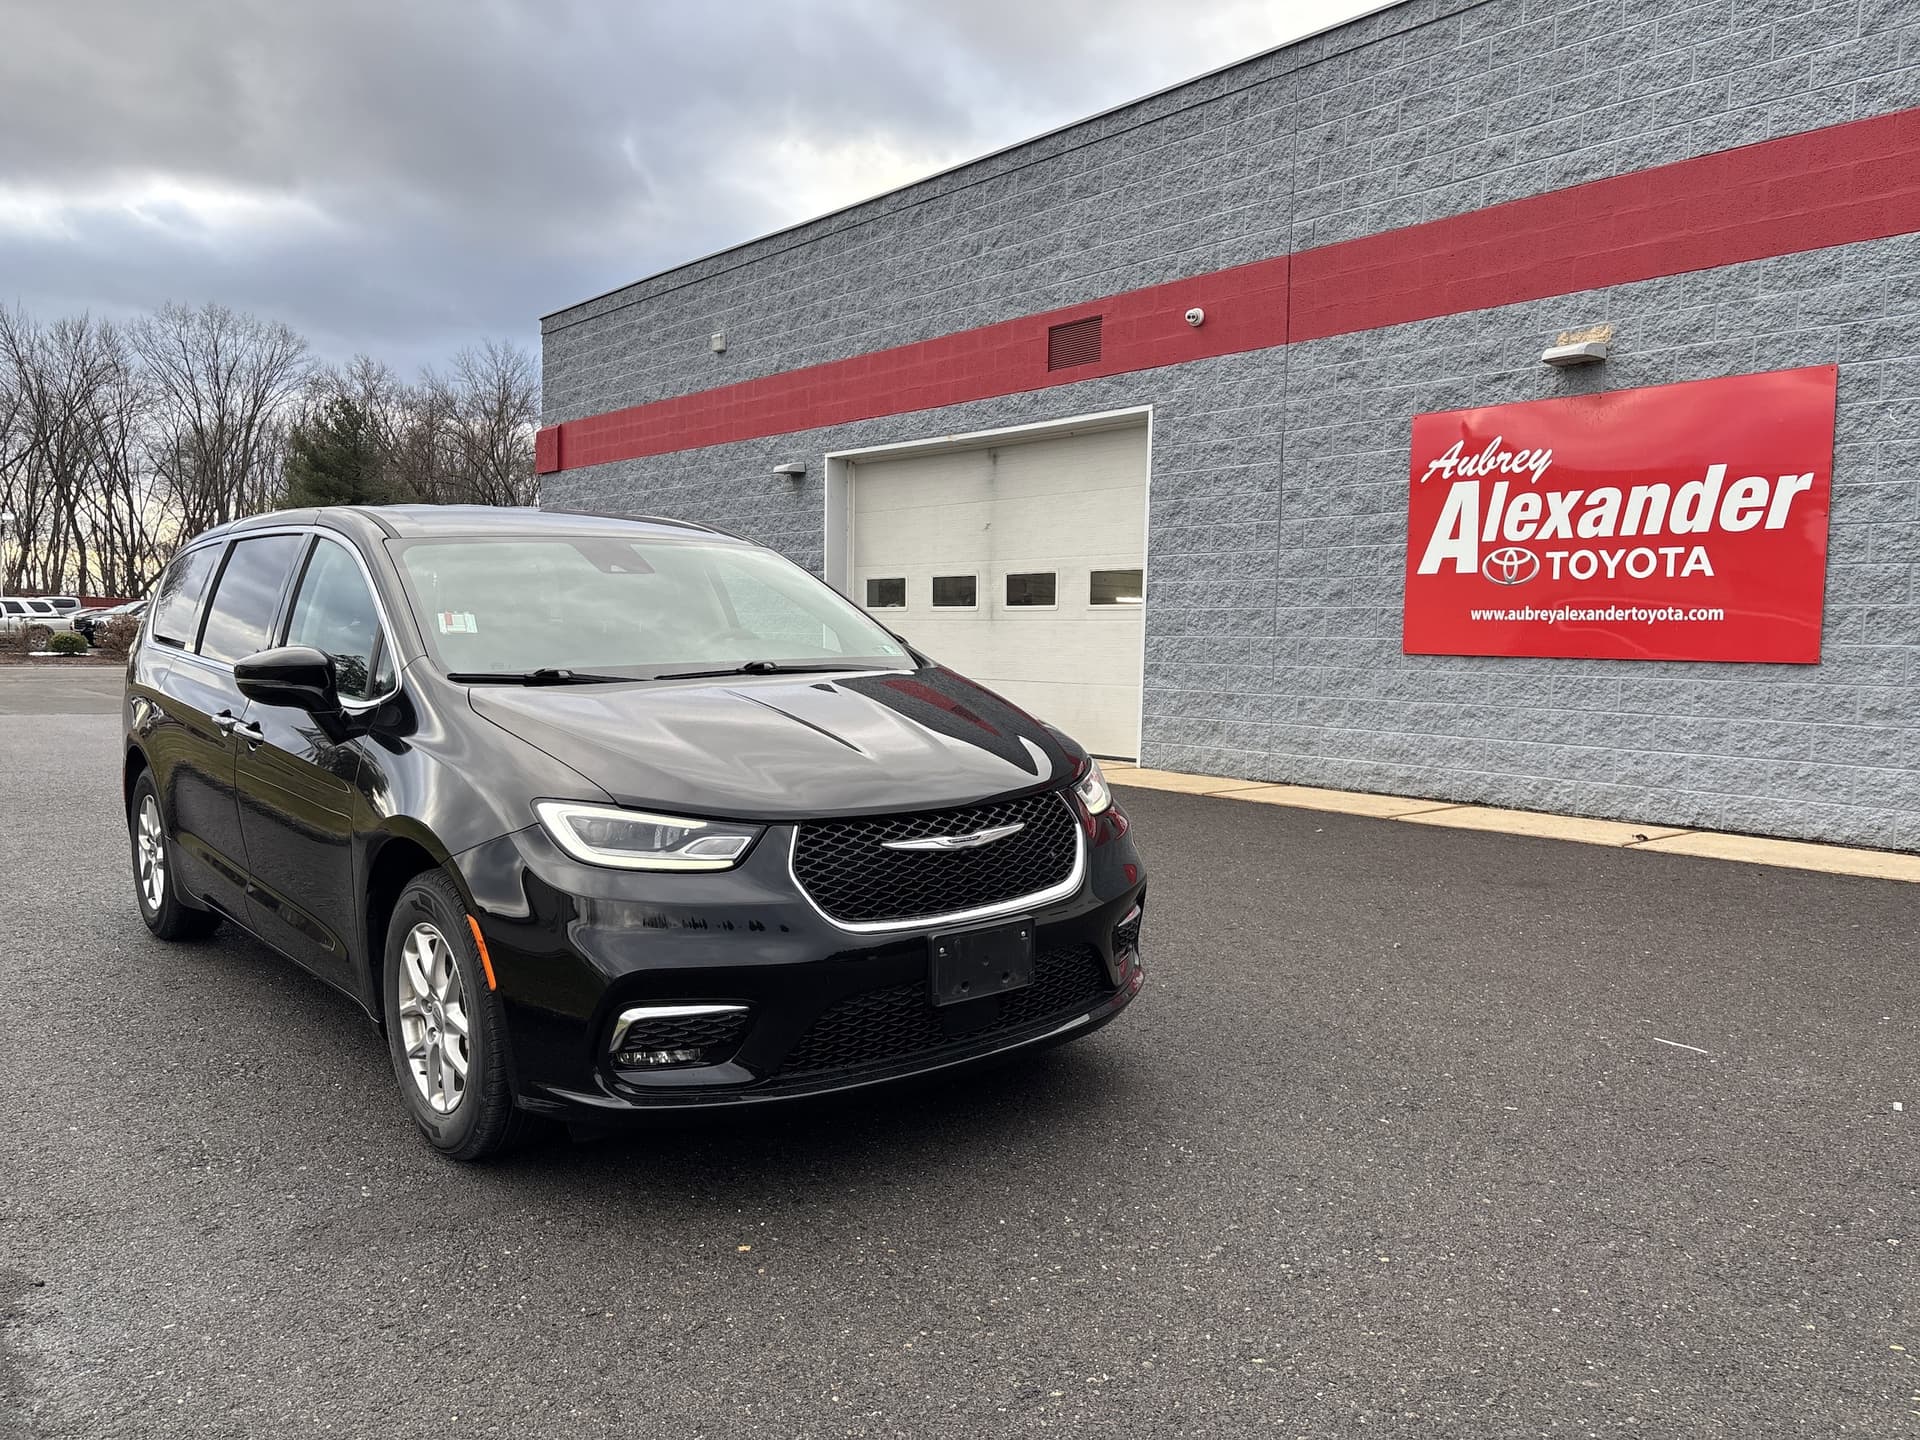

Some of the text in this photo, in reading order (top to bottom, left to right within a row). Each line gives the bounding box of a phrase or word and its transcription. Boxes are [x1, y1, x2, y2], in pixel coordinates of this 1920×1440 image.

[1420, 435, 1553, 484] Aubrey
[1417, 464, 1814, 575] Alexander
[1546, 546, 1714, 580] TOYOTA
[1471, 606, 1724, 625] www.aubreyalexandertoyota.com
